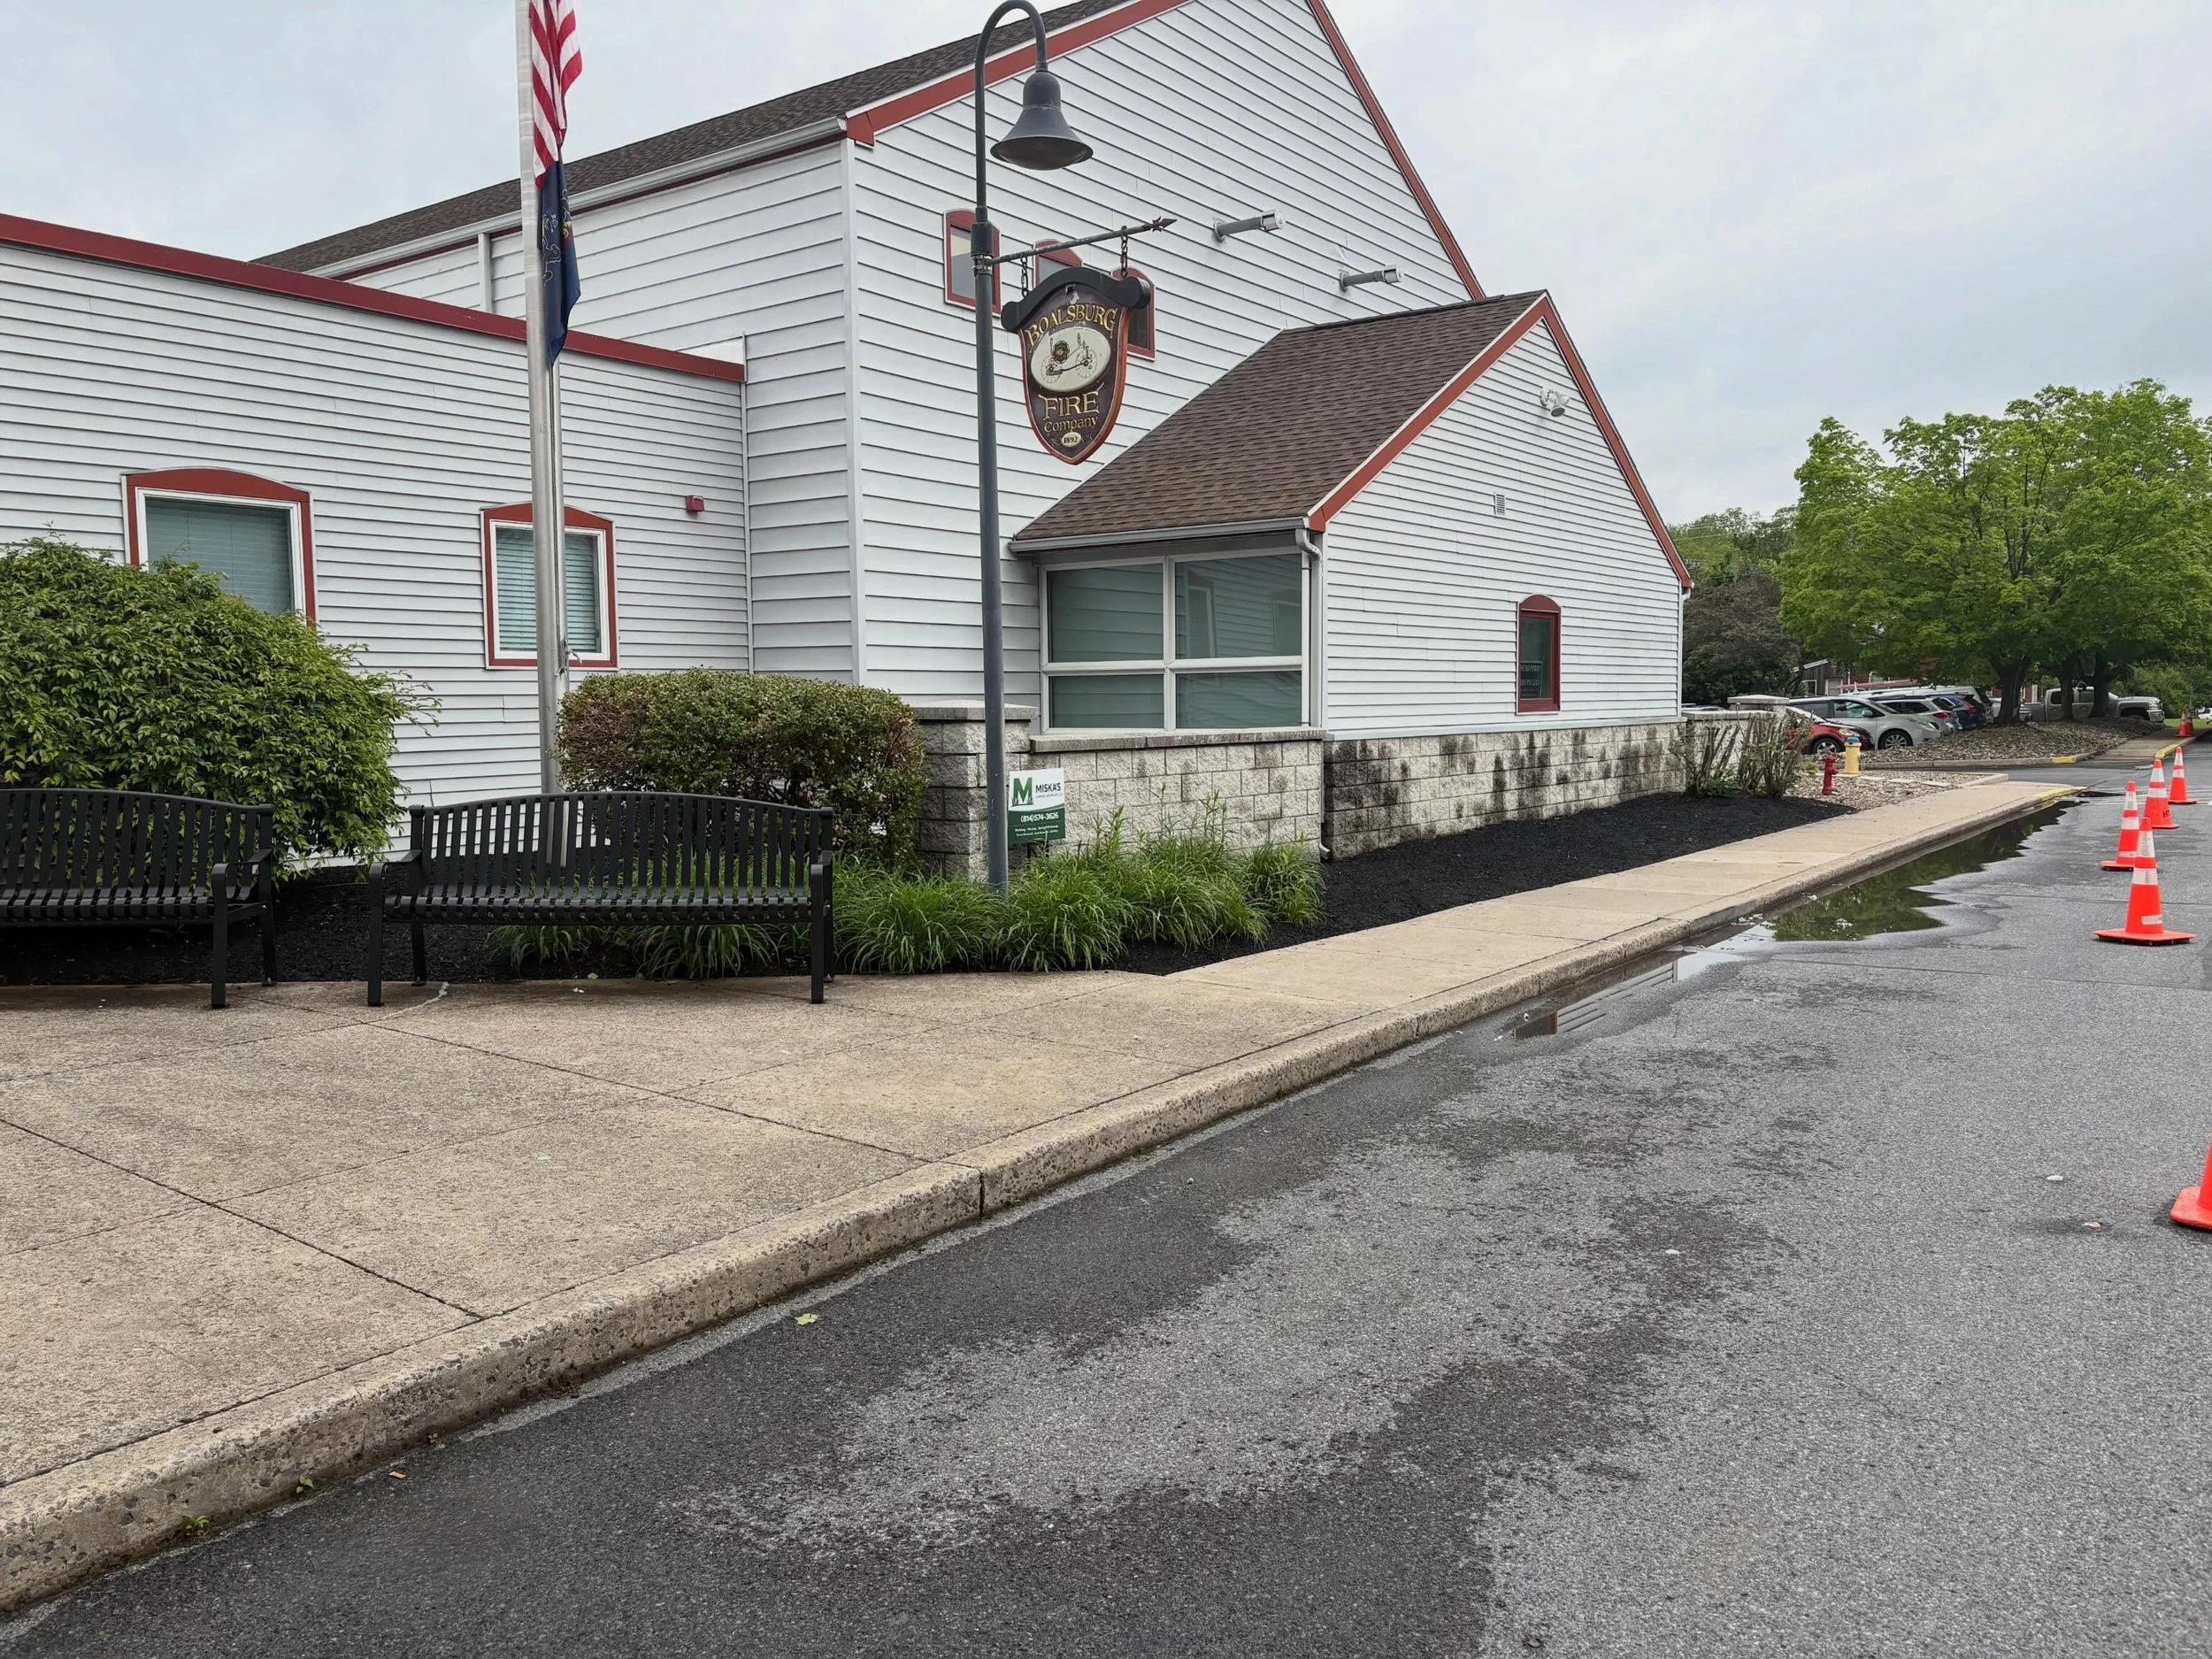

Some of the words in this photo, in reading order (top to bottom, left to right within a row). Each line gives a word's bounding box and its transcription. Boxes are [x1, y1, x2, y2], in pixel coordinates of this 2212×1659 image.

[1025, 303, 1118, 353] BOALSBURG
[1038, 382, 1105, 420] FIRE
[1043, 415, 1099, 434] Company
